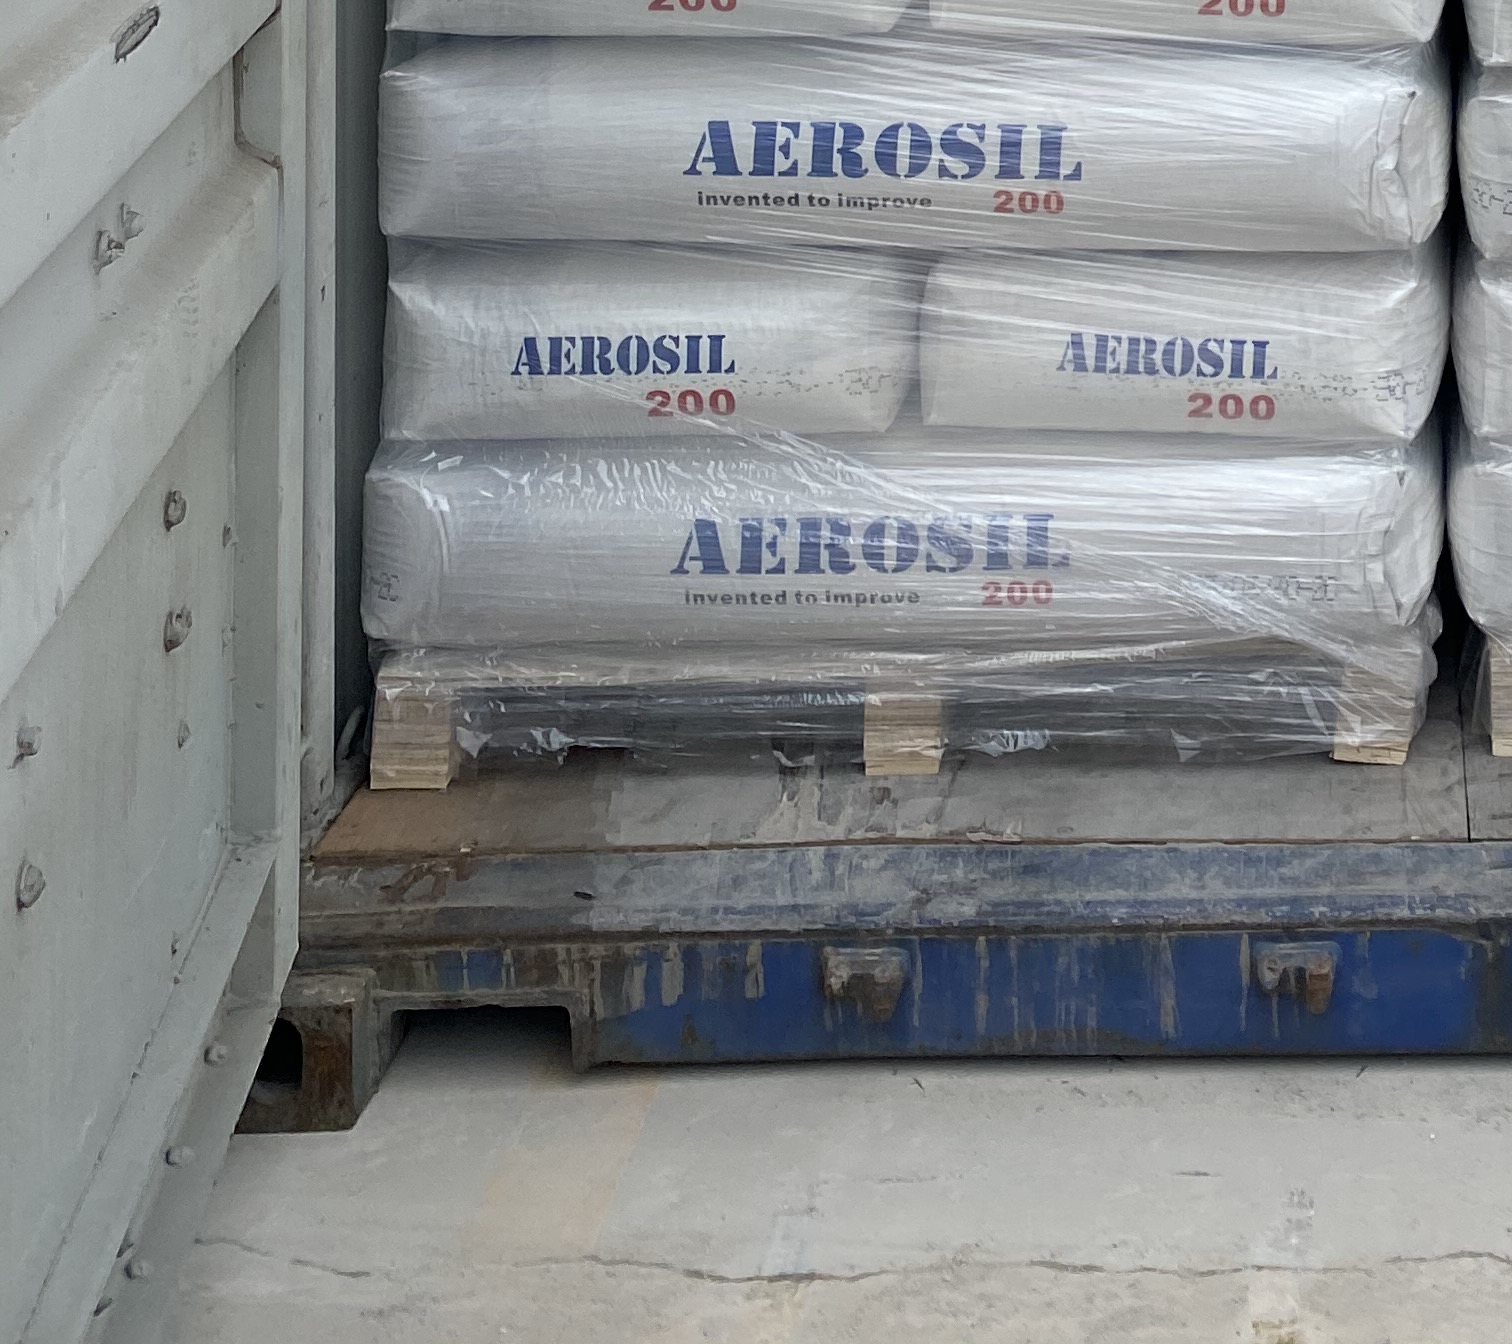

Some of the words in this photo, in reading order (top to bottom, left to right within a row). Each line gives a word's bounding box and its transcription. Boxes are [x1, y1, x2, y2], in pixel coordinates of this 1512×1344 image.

[682, 120, 1082, 179] AEROSIL
[698, 191, 799, 206] invented
[808, 193, 830, 207] to
[838, 193, 931, 210] improve
[994, 189, 1065, 214] 200
[511, 334, 736, 376] AEROSIL
[1056, 333, 1279, 380] AEROSIL
[648, 387, 735, 416] 200
[1188, 392, 1276, 420] 200
[670, 513, 1071, 575] AEROSIL
[685, 590, 786, 605] invented
[795, 591, 817, 604] to
[825, 591, 920, 607] improve
[982, 578, 1053, 608] 200
